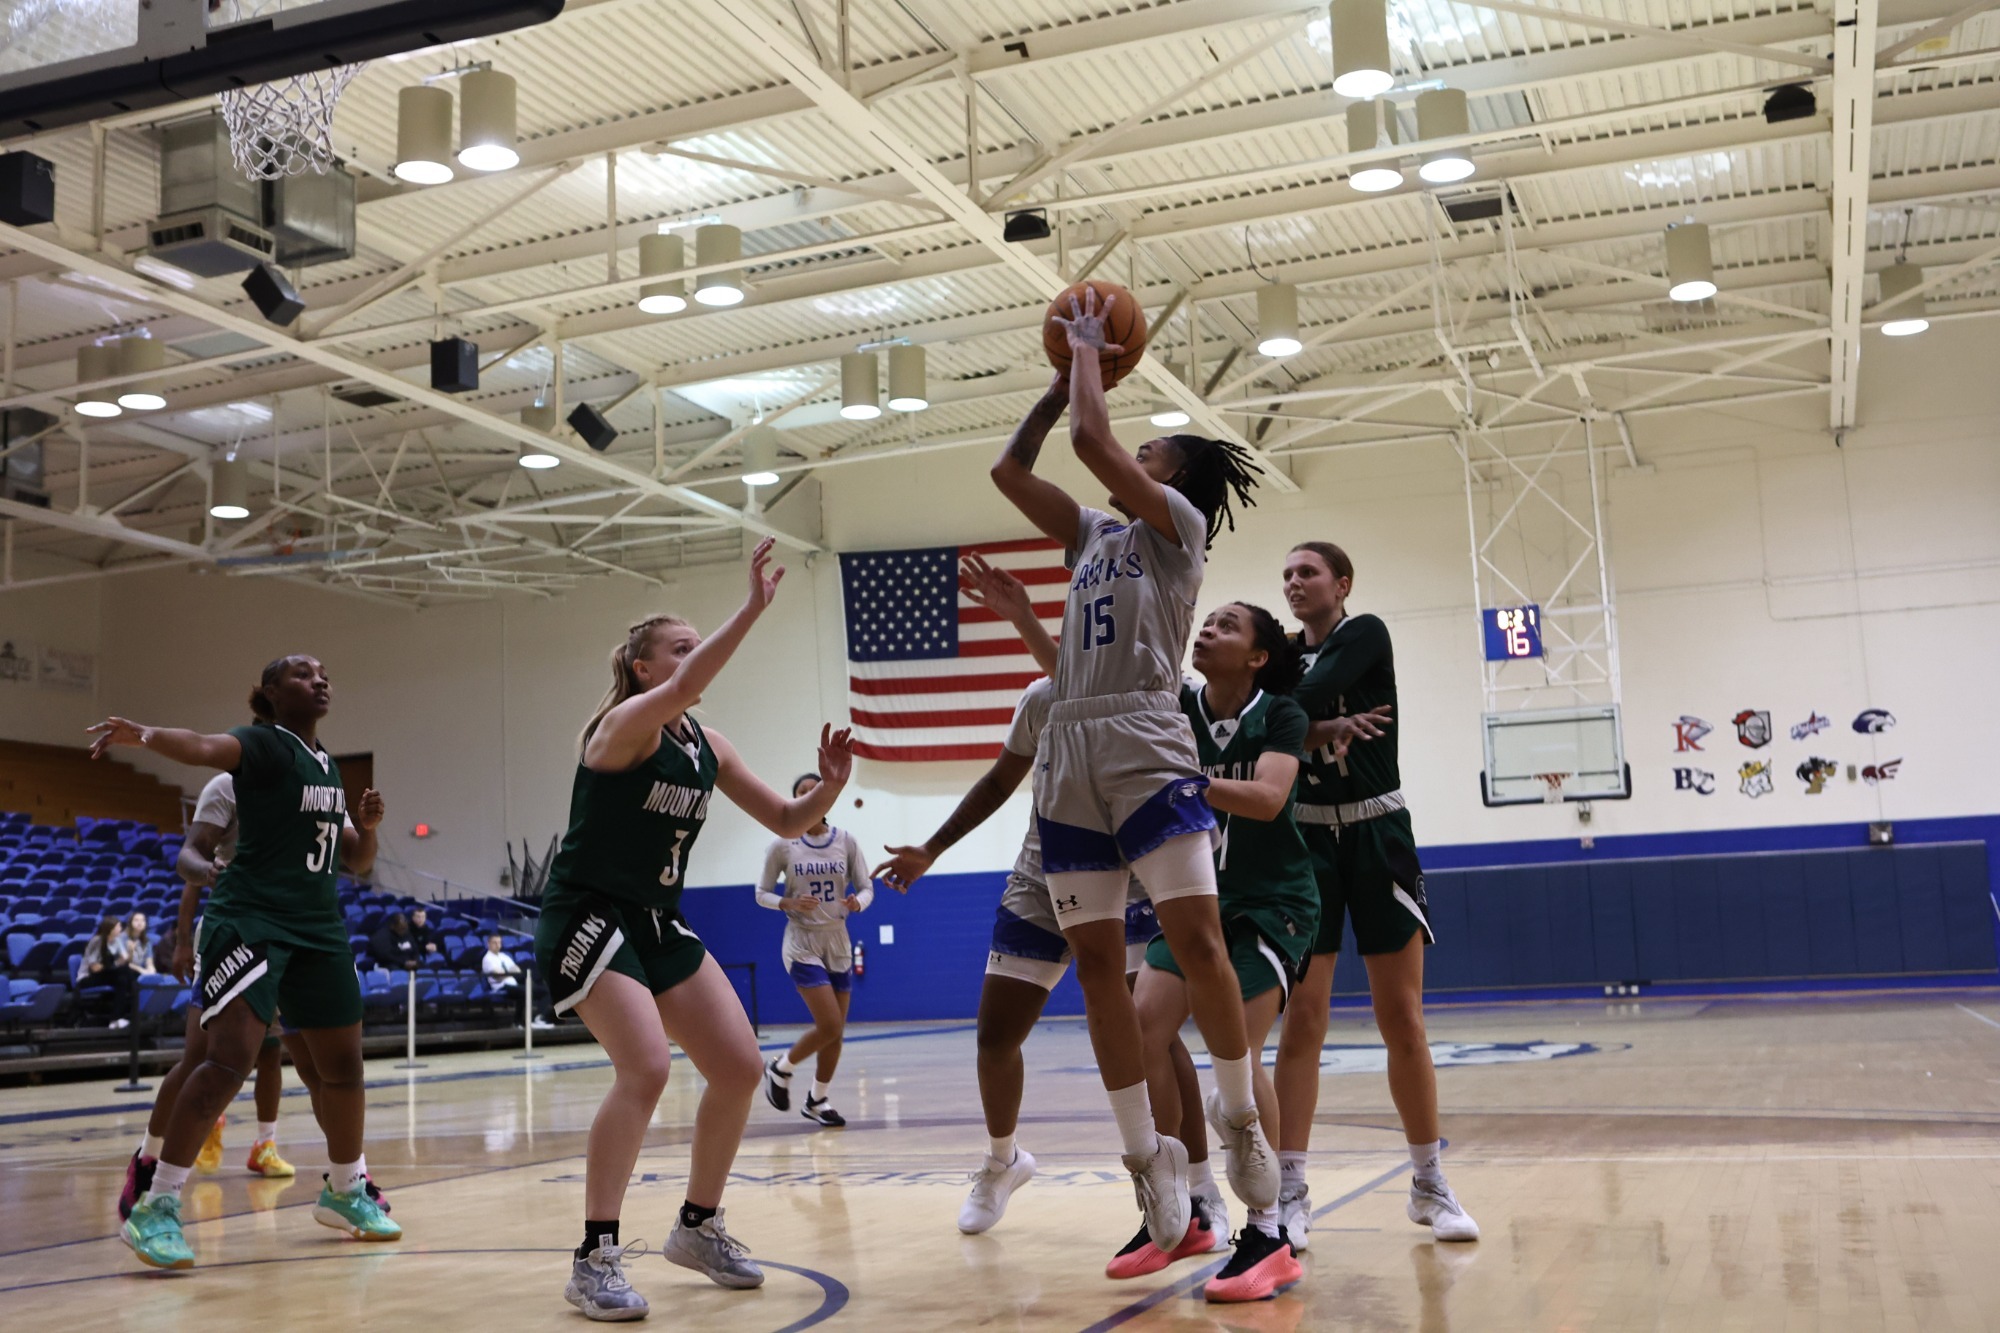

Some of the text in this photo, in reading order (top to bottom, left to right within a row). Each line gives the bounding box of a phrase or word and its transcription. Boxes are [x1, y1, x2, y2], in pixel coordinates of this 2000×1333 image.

[1082, 594, 1116, 651] 15
[1507, 626, 1530, 656] 16
[300, 785, 335, 812] MOUNT
[642, 780, 701, 818] MOUNT
[306, 821, 338, 874] 31
[659, 829, 690, 886] 3
[794, 862, 845, 876] HAWKS
[810, 880, 835, 902] 22
[560, 912, 606, 981] TROJANS
[205, 943, 254, 999] TROJANS
